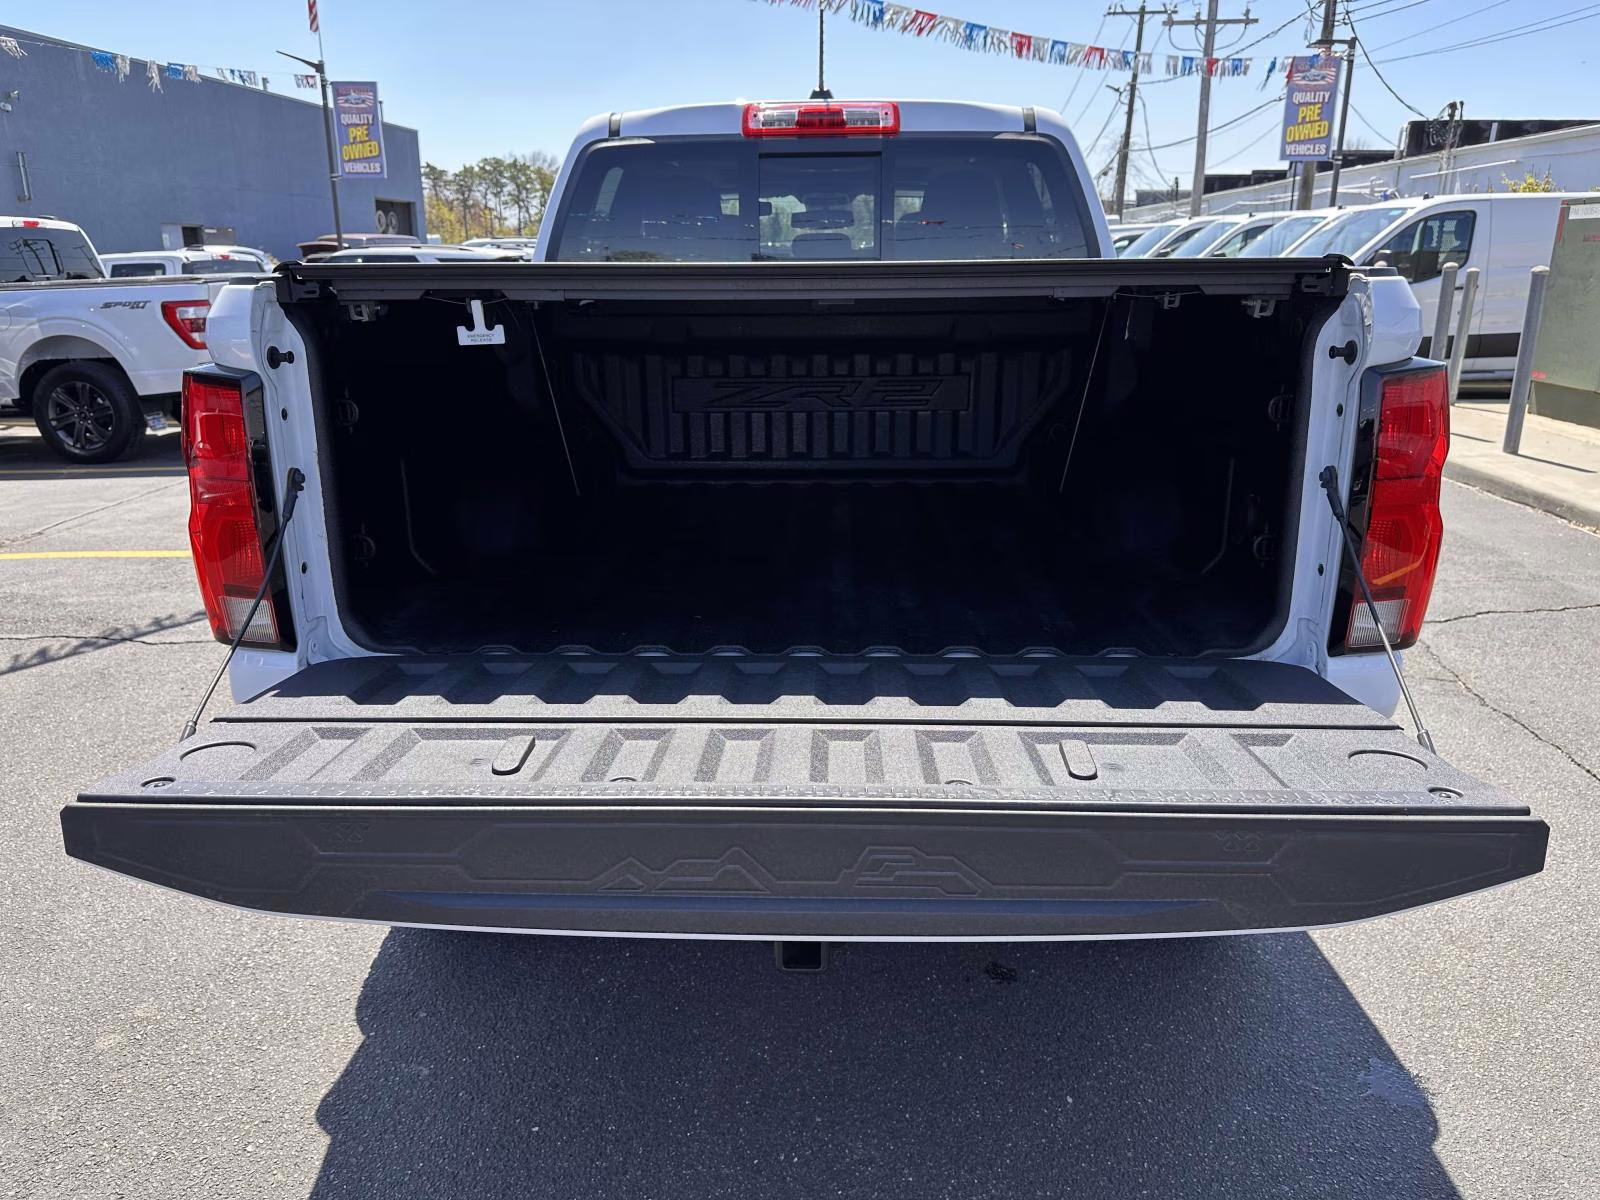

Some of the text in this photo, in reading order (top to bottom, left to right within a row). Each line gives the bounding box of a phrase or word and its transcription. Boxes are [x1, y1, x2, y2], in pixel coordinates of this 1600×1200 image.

[1292, 91, 1331, 104] QUALITY
[341, 113, 374, 126] QUALITY
[1298, 104, 1322, 123] PRE
[349, 126, 368, 143] PRE
[1286, 121, 1329, 142] OWNED
[342, 142, 379, 160] OWNED
[1285, 143, 1328, 156] VEHICLES
[344, 162, 382, 174] VEHICLES
